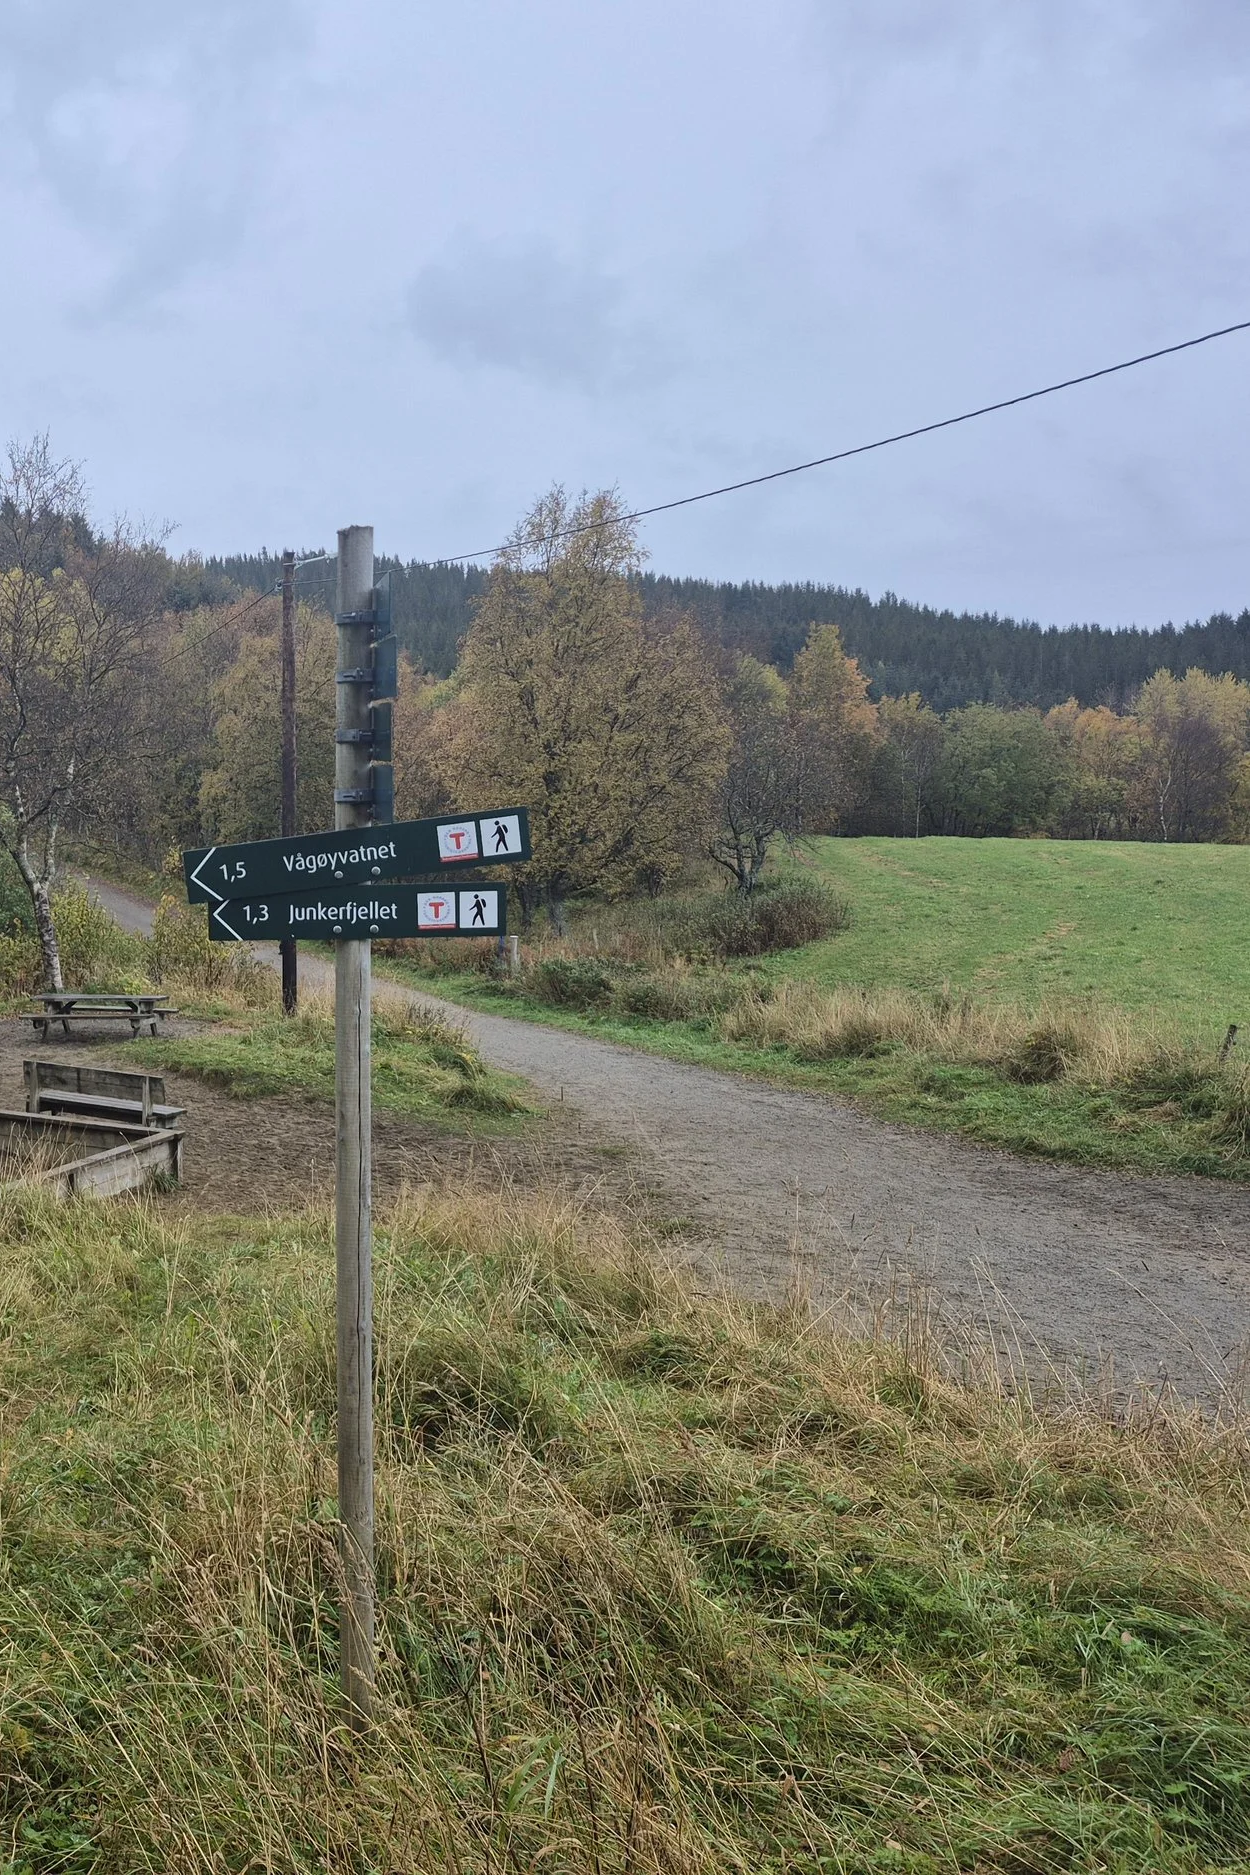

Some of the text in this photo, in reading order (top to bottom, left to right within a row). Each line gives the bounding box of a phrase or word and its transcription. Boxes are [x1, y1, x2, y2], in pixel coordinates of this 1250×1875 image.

[449, 832, 465, 850] T
[219, 842, 397, 883] 1,5 Vågøyvatnet
[242, 904, 270, 924] 1,3
[288, 901, 398, 924] Junkerfjellet
[429, 902, 445, 919] T
